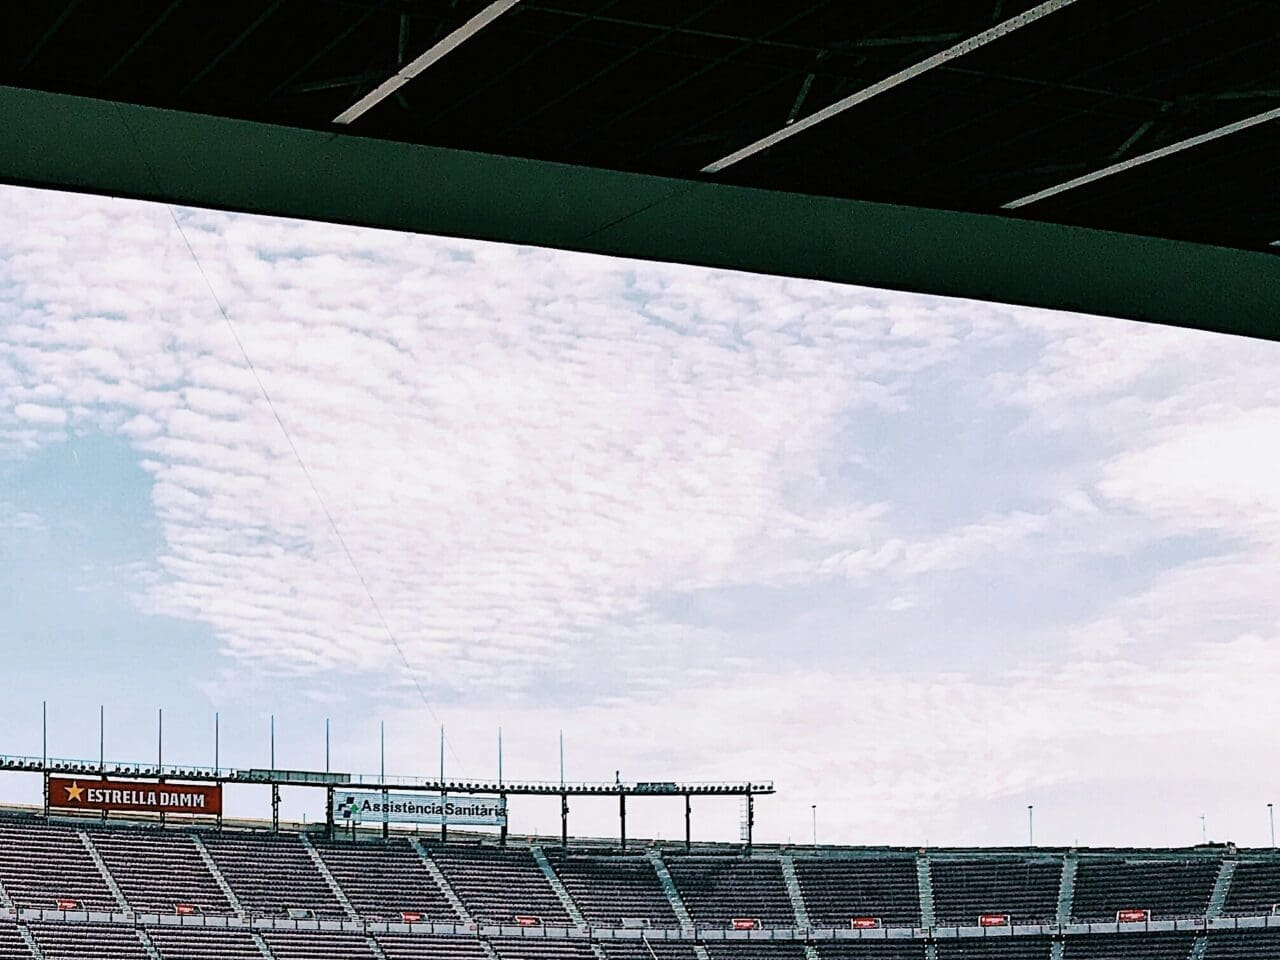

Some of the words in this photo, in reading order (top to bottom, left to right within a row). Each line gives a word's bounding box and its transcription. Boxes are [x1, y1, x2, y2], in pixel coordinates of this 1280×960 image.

[87, 788, 157, 806] ESTRELLA
[160, 792, 205, 808] DAMM
[360, 799, 443, 815] Assistència
